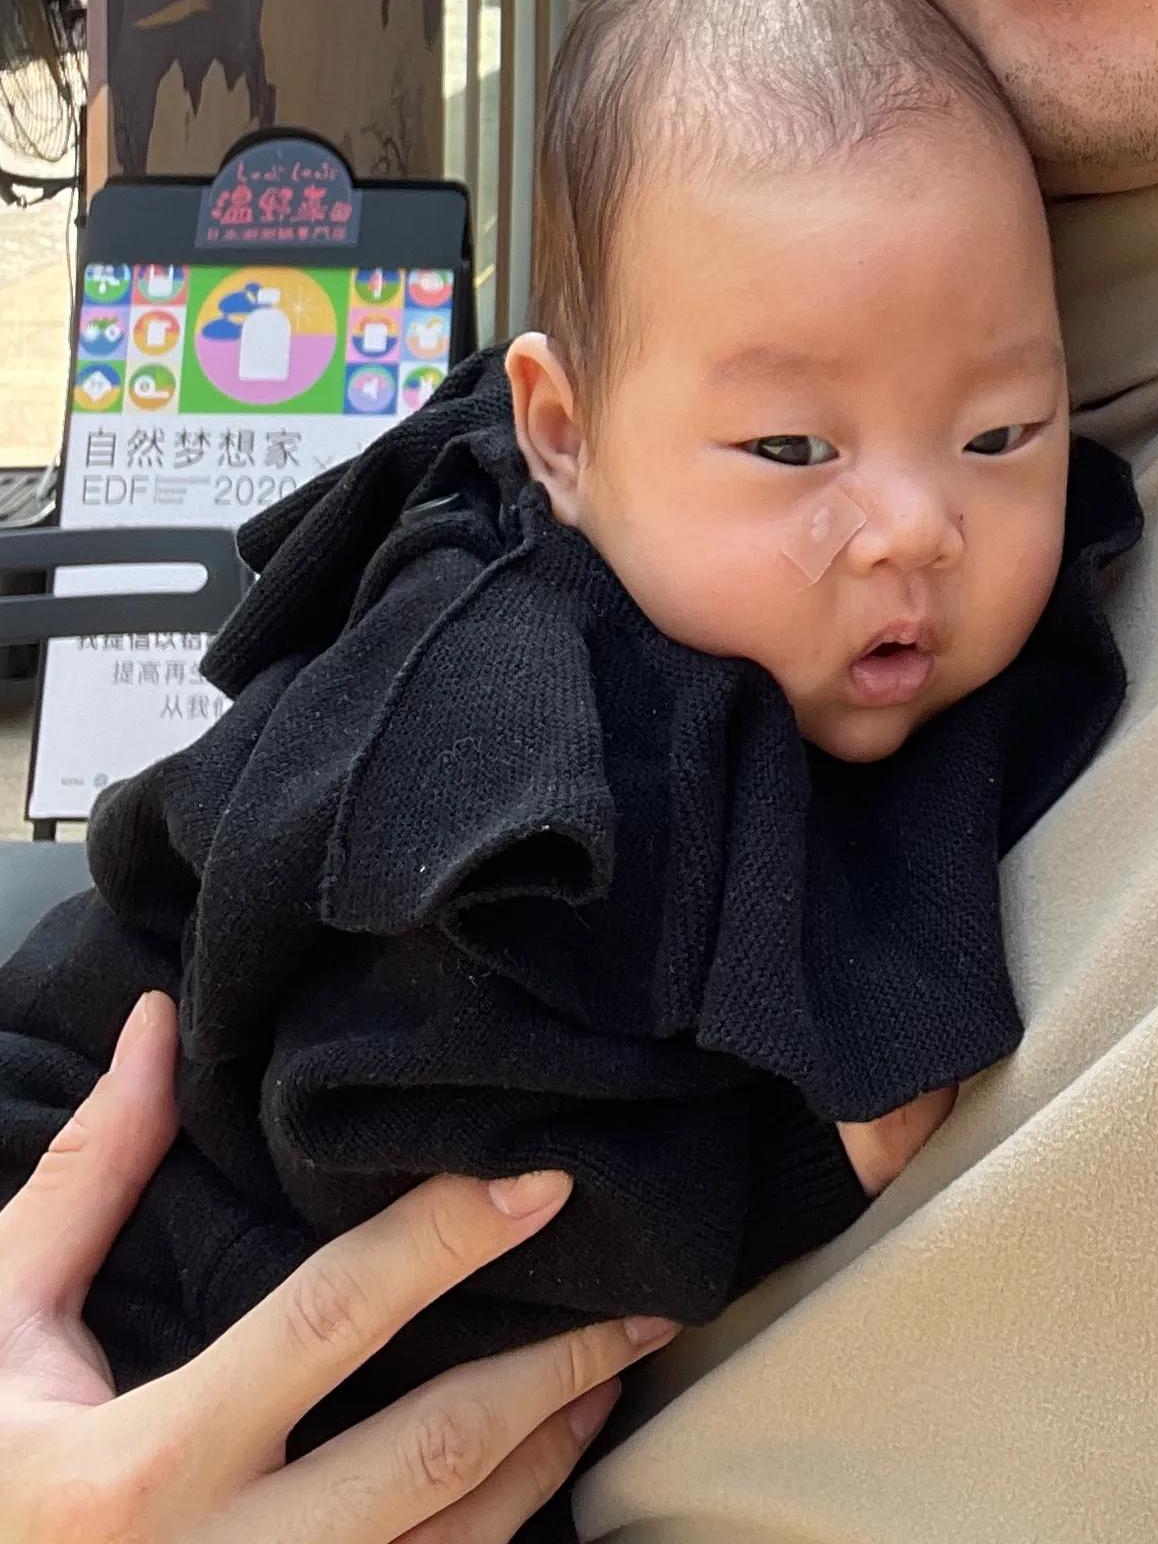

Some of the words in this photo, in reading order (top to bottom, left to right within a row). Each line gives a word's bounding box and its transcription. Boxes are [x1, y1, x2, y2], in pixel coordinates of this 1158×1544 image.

[85, 427, 302, 470] 自然梦想家
[82, 474, 149, 506] EDF
